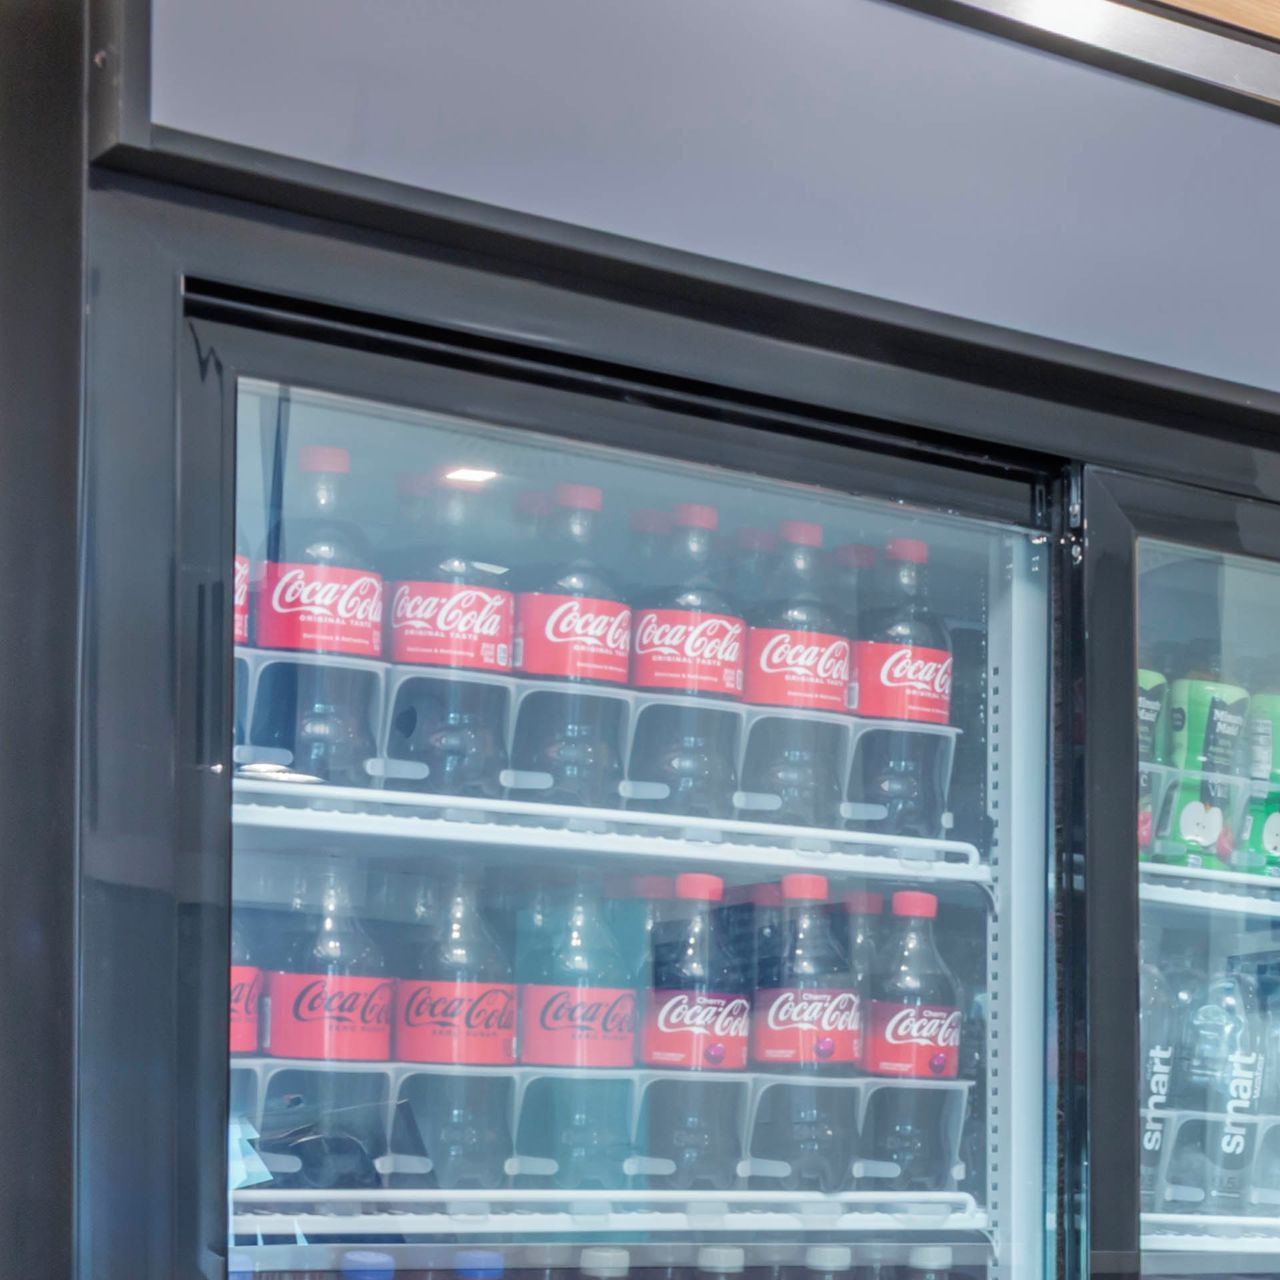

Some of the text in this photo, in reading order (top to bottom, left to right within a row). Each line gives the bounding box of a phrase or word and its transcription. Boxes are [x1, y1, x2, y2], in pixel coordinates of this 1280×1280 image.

[391, 584, 503, 636] Coca-Cola
[635, 613, 740, 663] Coca-Cola
[1143, 1044, 1173, 1151] smart
[1221, 1050, 1257, 1156] smart
